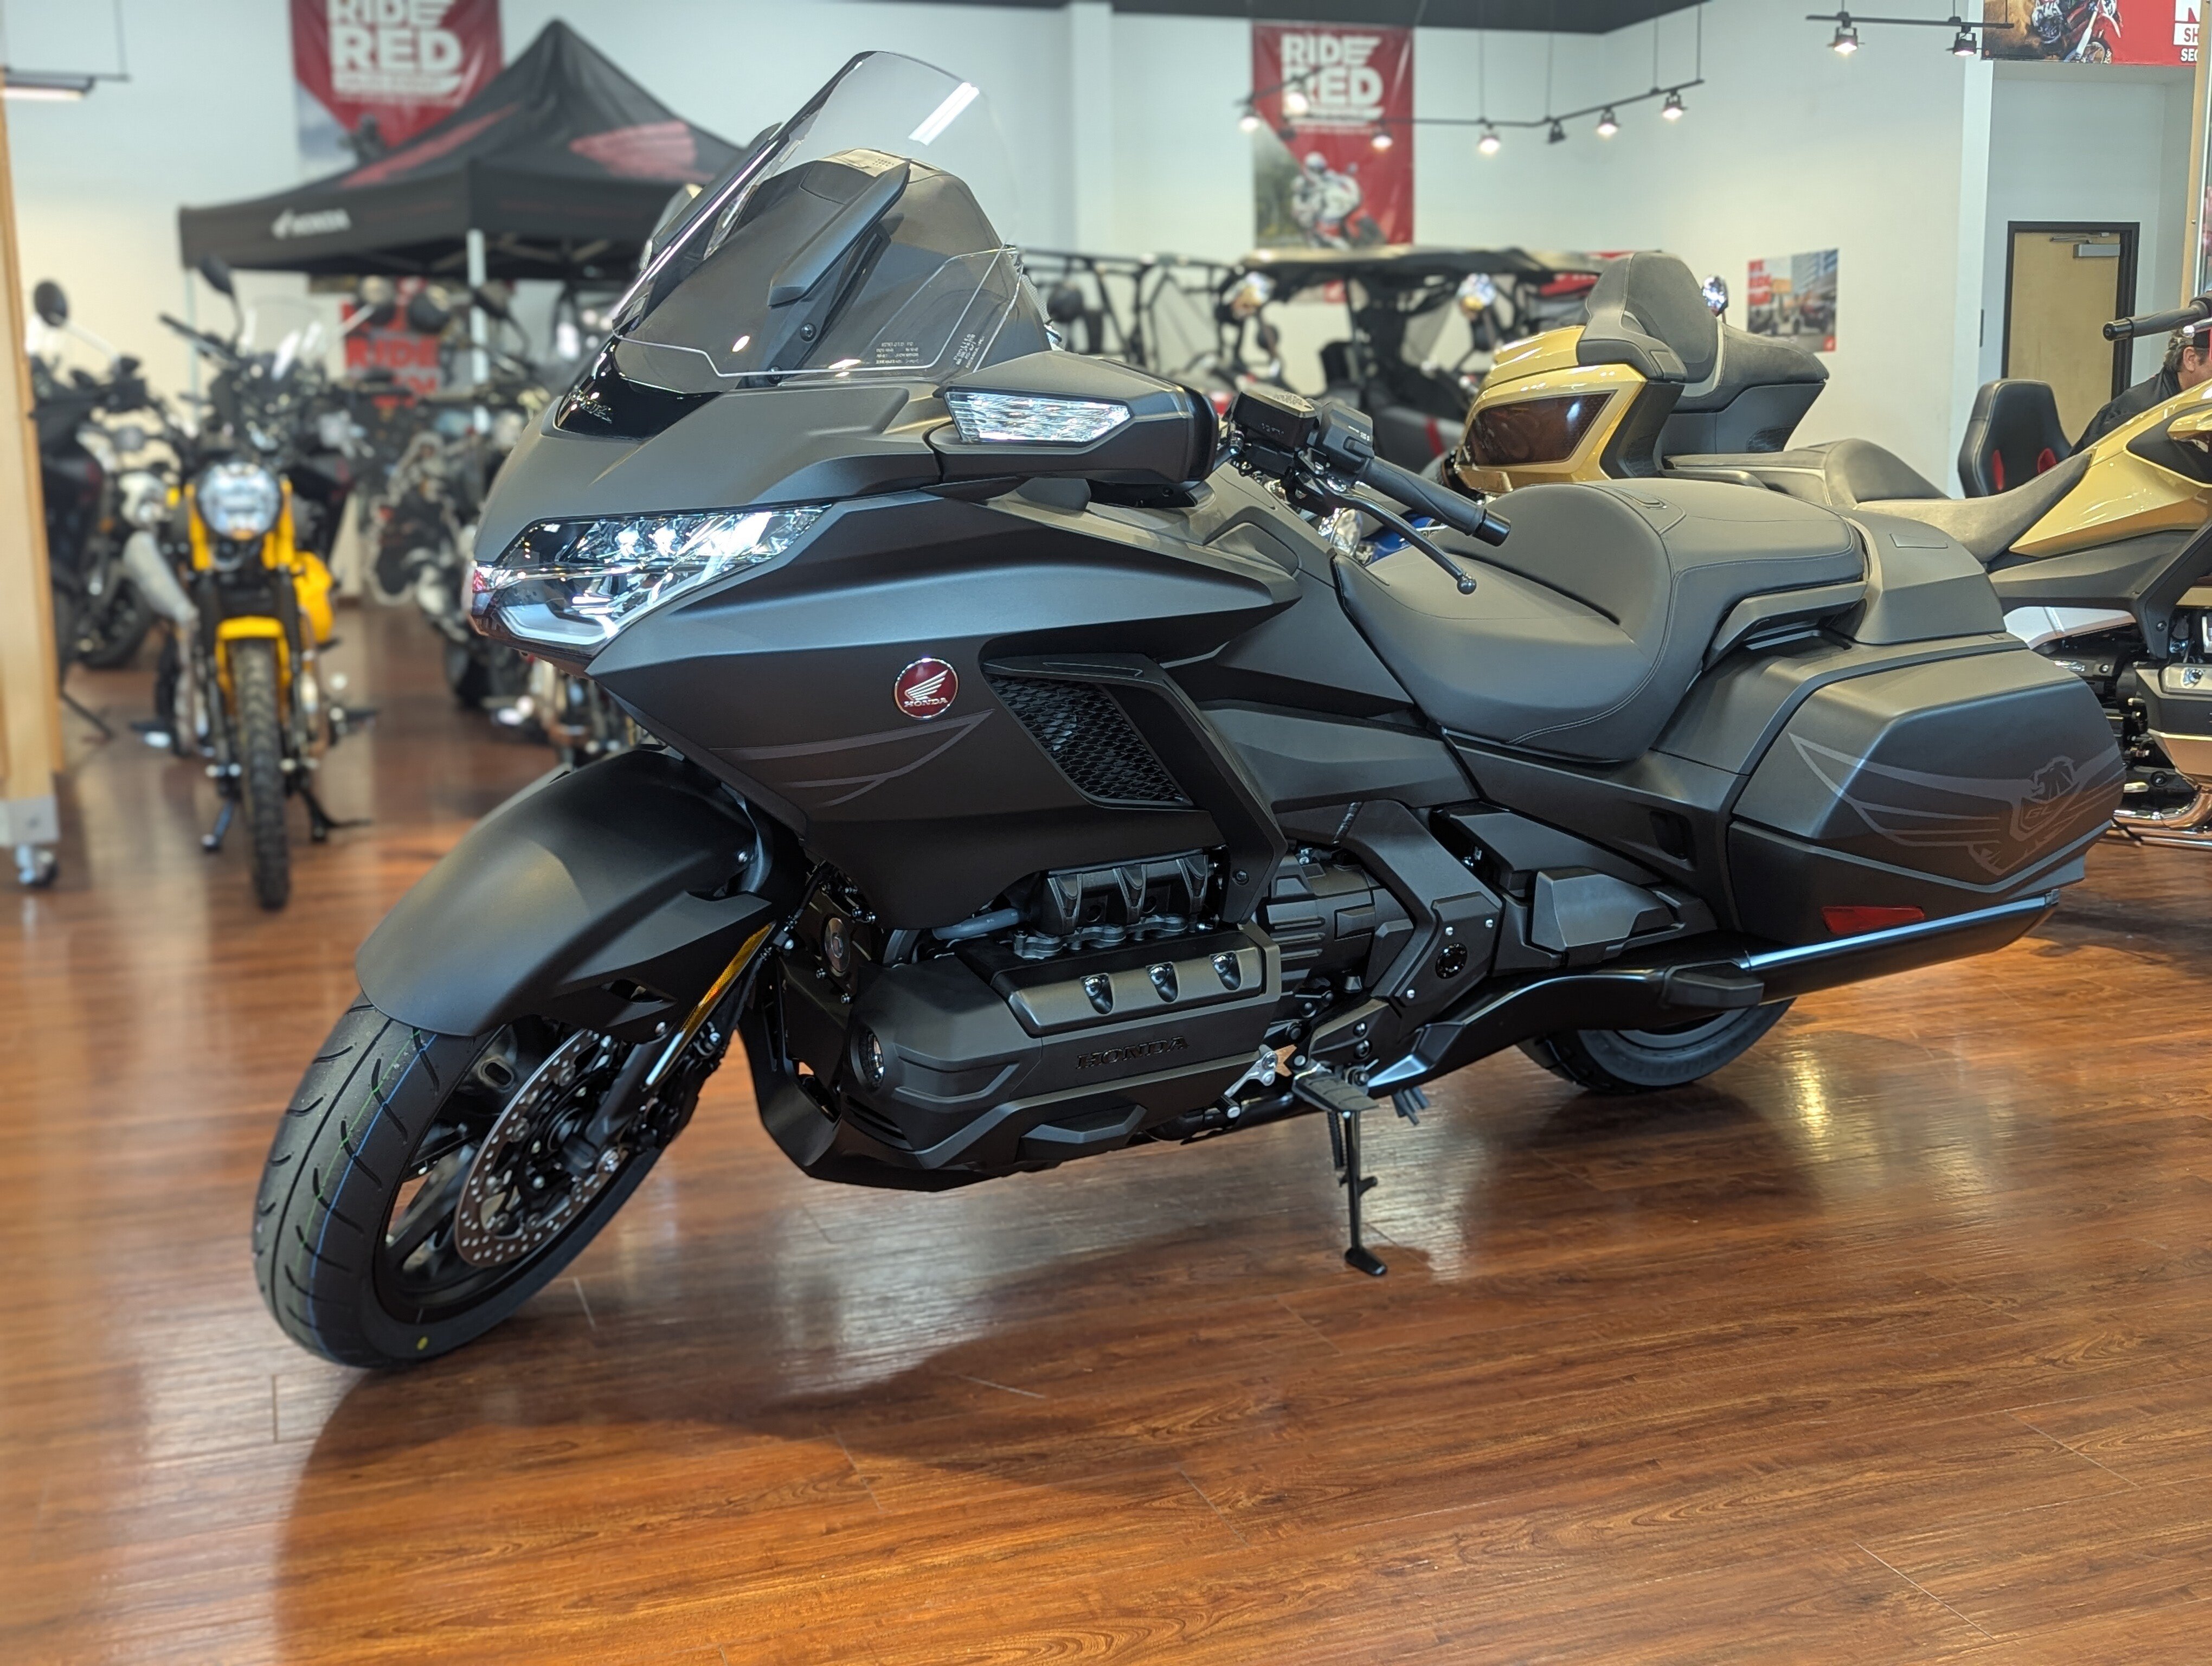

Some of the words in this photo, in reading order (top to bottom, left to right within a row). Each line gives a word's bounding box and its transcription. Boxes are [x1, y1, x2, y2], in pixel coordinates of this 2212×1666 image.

[328, 0, 455, 26] RIDE
[331, 27, 462, 71] RED
[1281, 34, 1380, 66] RIDE
[1282, 66, 1384, 106] RED
[904, 697, 949, 707] HONDA
[2024, 805, 2053, 819] GL
[1076, 1035, 1190, 1070] HONDA
